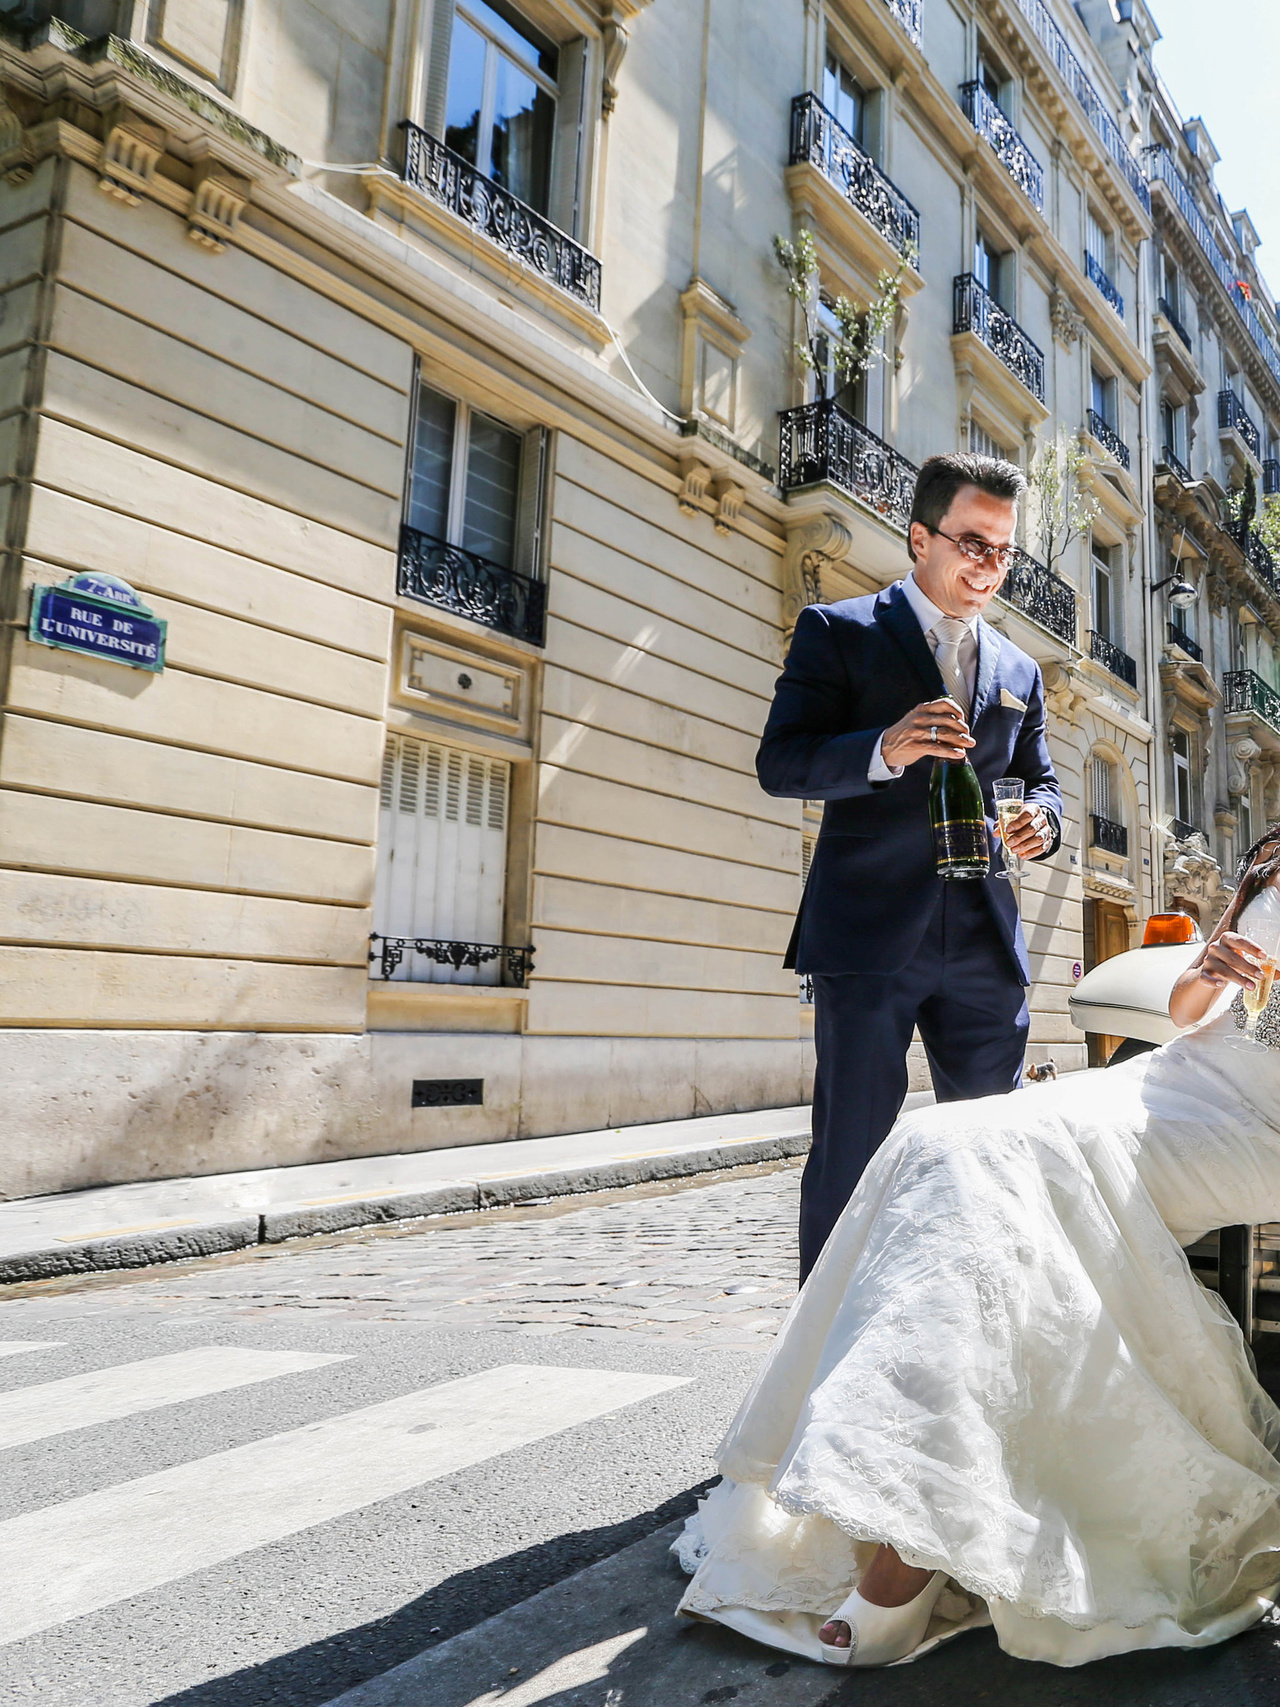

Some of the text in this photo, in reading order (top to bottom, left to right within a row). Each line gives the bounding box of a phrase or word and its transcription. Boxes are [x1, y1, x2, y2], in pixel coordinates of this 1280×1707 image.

[41, 617, 156, 659] L'UNIVERSITÉ
[70, 606, 133, 635] RUE DE
